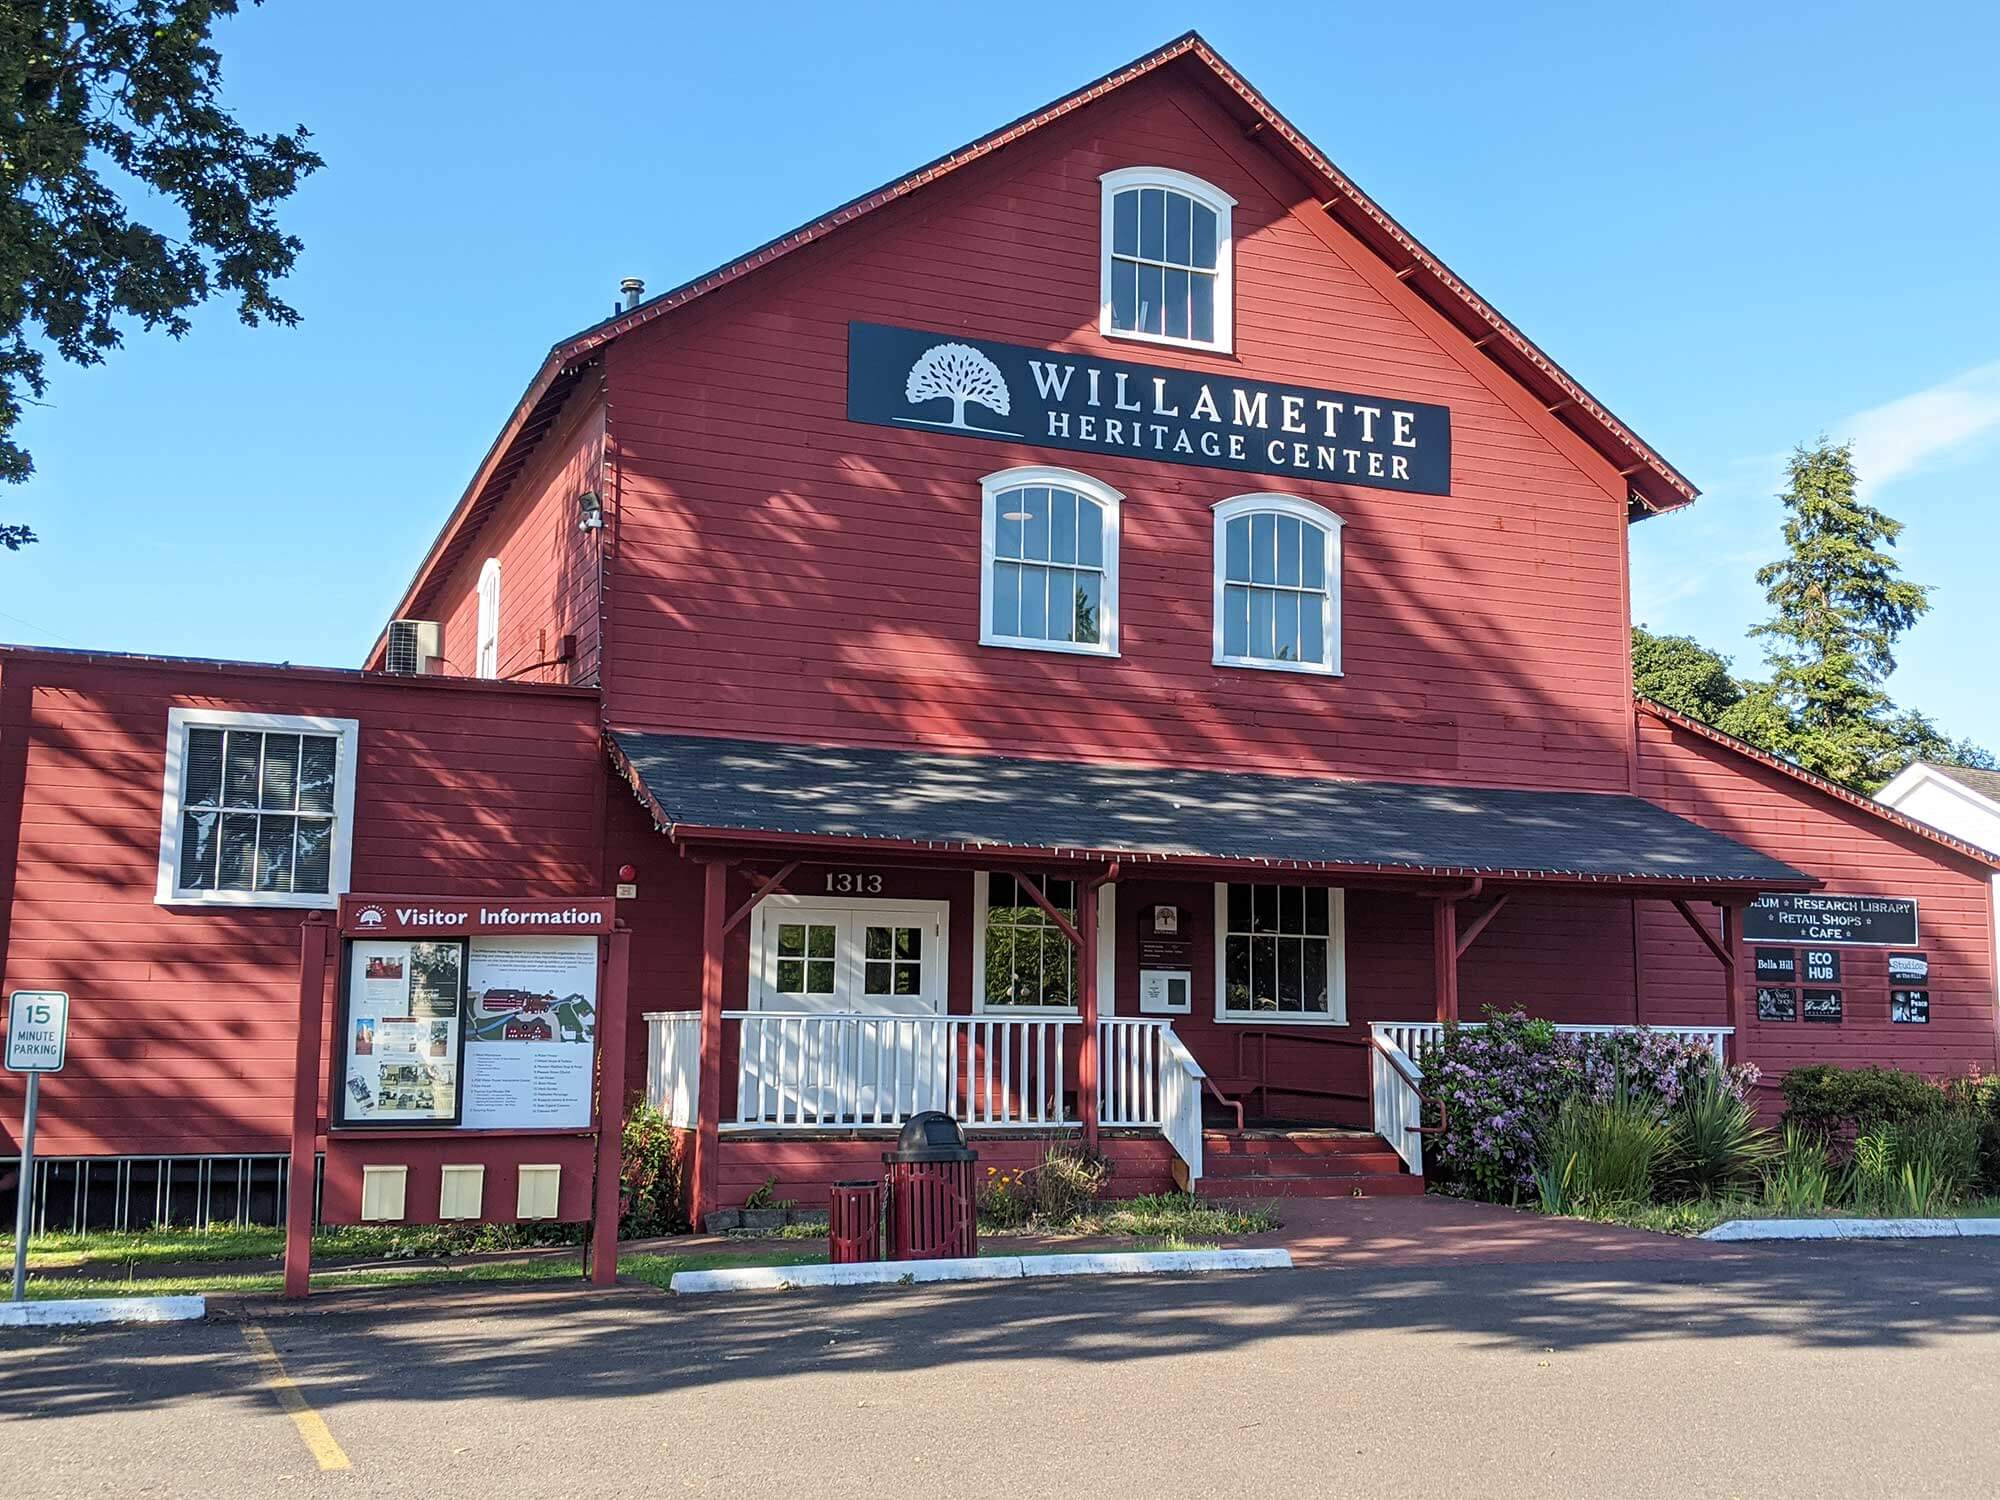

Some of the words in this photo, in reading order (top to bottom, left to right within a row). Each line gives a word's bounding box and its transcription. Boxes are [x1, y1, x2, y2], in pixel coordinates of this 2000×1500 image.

[1029, 360, 1417, 449] WILLAMETTE
[1047, 410, 1246, 461] HERITAGE
[1266, 439, 1410, 481] CENTER
[825, 872, 883, 893] 1313
[1794, 897, 1858, 912] RESEARCH
[1860, 900, 1910, 914] LIBRARY
[395, 908, 468, 925] Visitor
[480, 908, 602, 925] Information
[1778, 912, 1820, 925] RETAIL
[1822, 914, 1862, 926] SHOPS
[1809, 926, 1842, 939] CAFE
[1778, 960, 1794, 970] Hill
[1808, 952, 1832, 965] ECO
[1808, 967, 1834, 979] HUB
[26, 1005, 51, 1025] 15
[17, 1031, 55, 1042] MINUTE
[14, 1044, 57, 1055] PARKING
